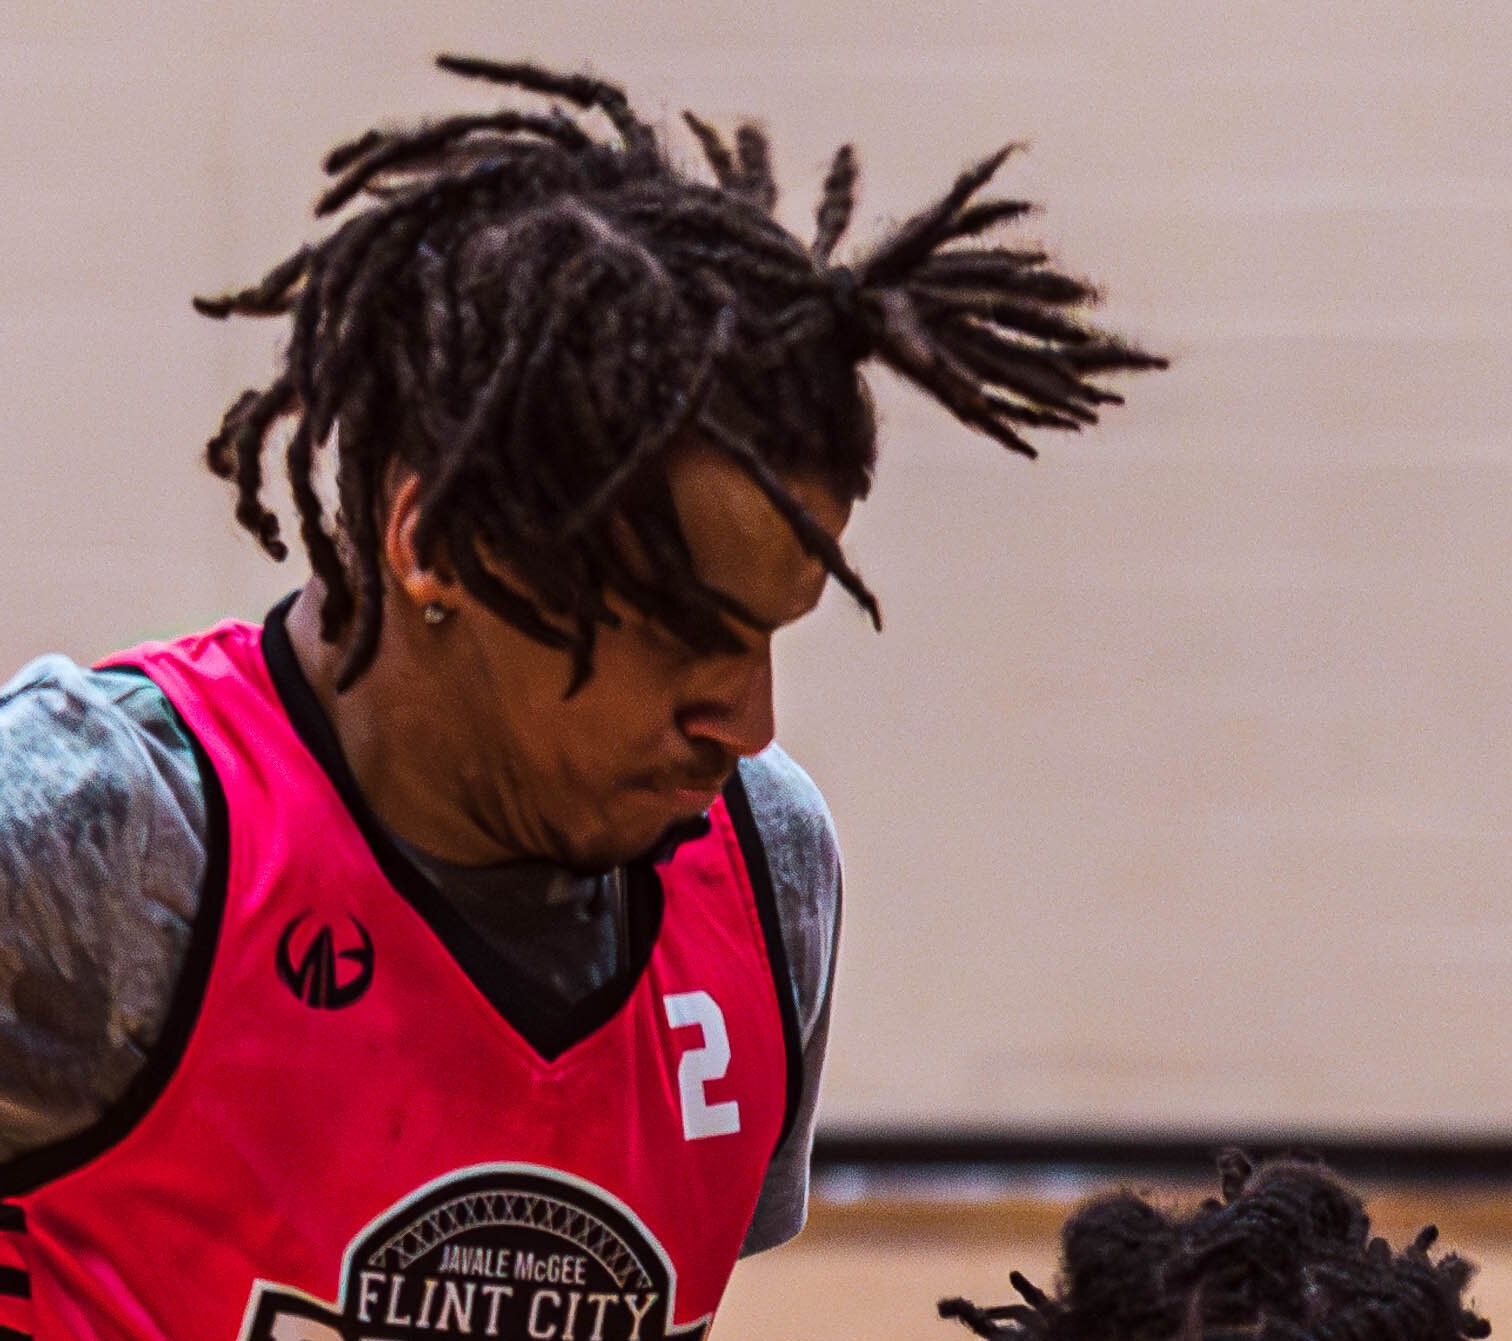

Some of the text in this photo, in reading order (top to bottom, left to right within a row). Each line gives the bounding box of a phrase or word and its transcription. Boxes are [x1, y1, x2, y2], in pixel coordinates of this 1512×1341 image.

[663, 990, 741, 1141] 2
[439, 1245, 587, 1285] JAVALE McGEE
[357, 1272, 514, 1336] FLINT
